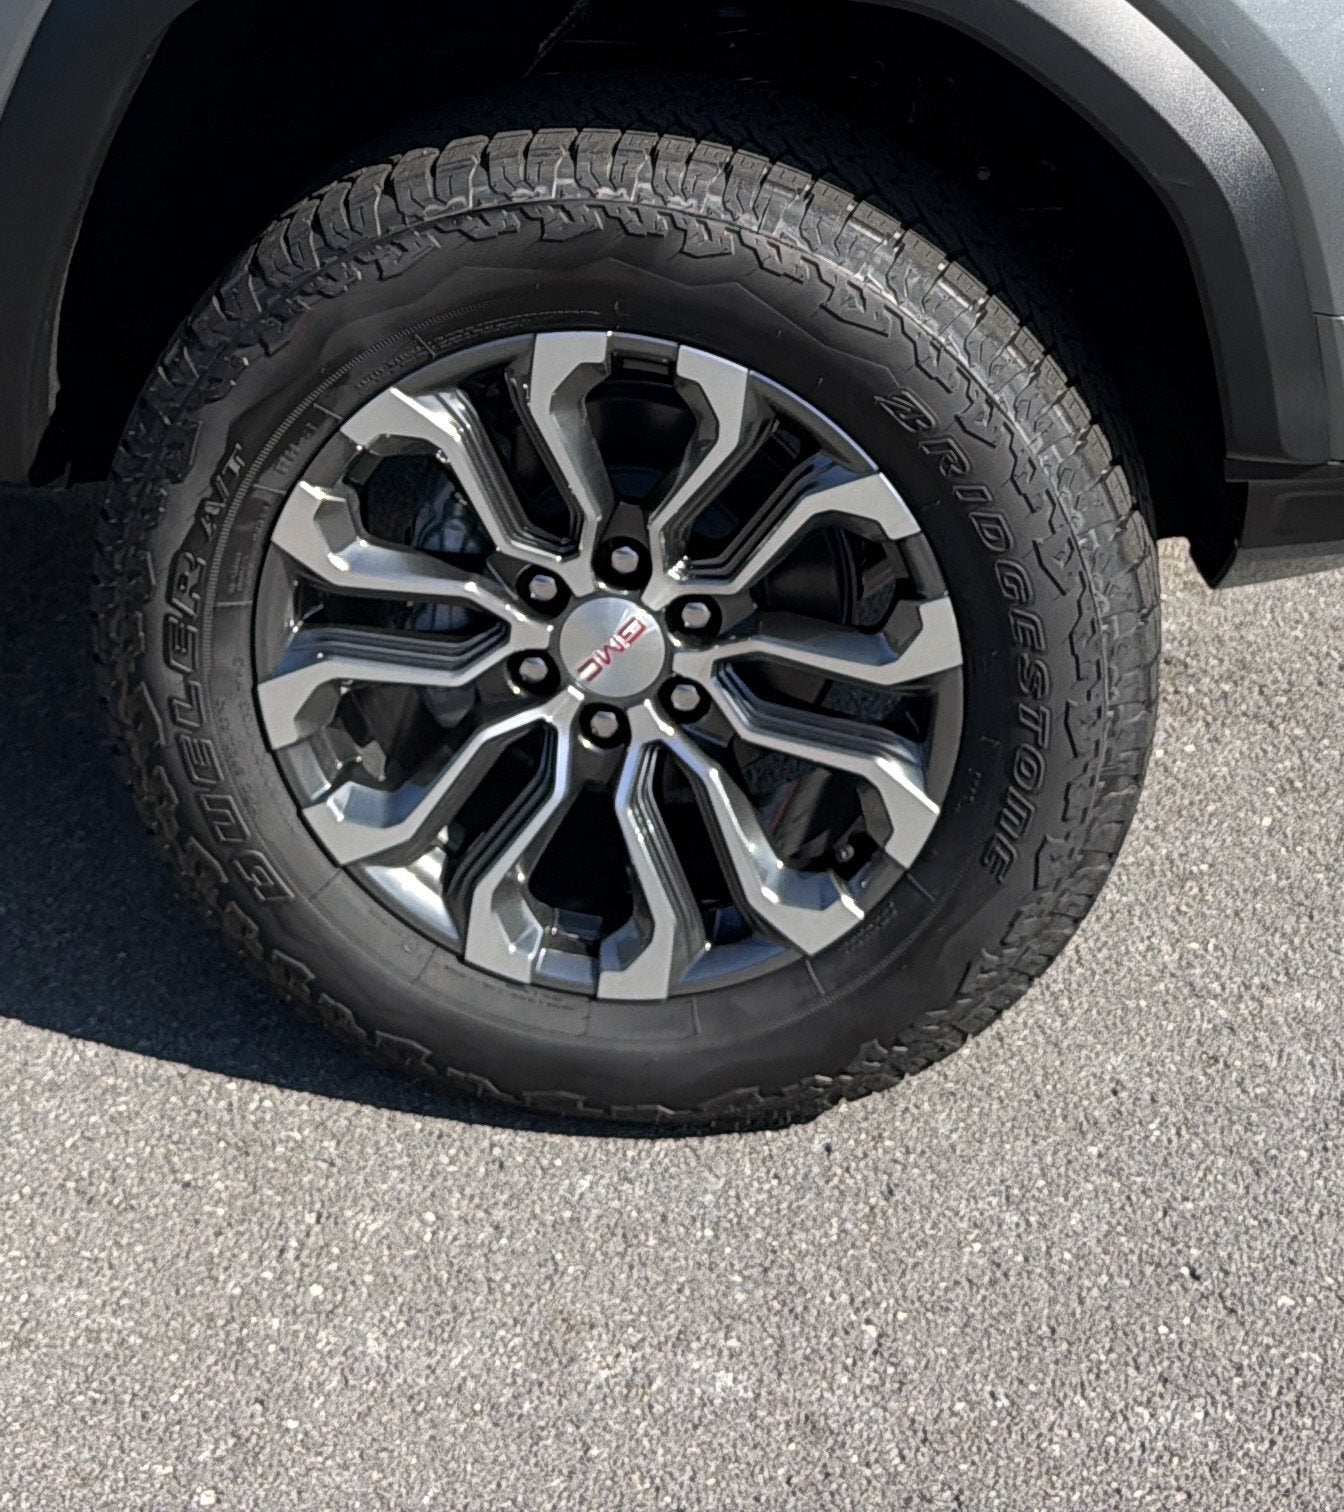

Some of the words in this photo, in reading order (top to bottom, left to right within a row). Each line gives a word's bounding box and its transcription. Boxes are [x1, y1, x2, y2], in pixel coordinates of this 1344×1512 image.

[163, 549, 296, 902] DUELER
[576, 616, 647, 683] GMC
[873, 390, 1052, 885] BRIDGESTONE
